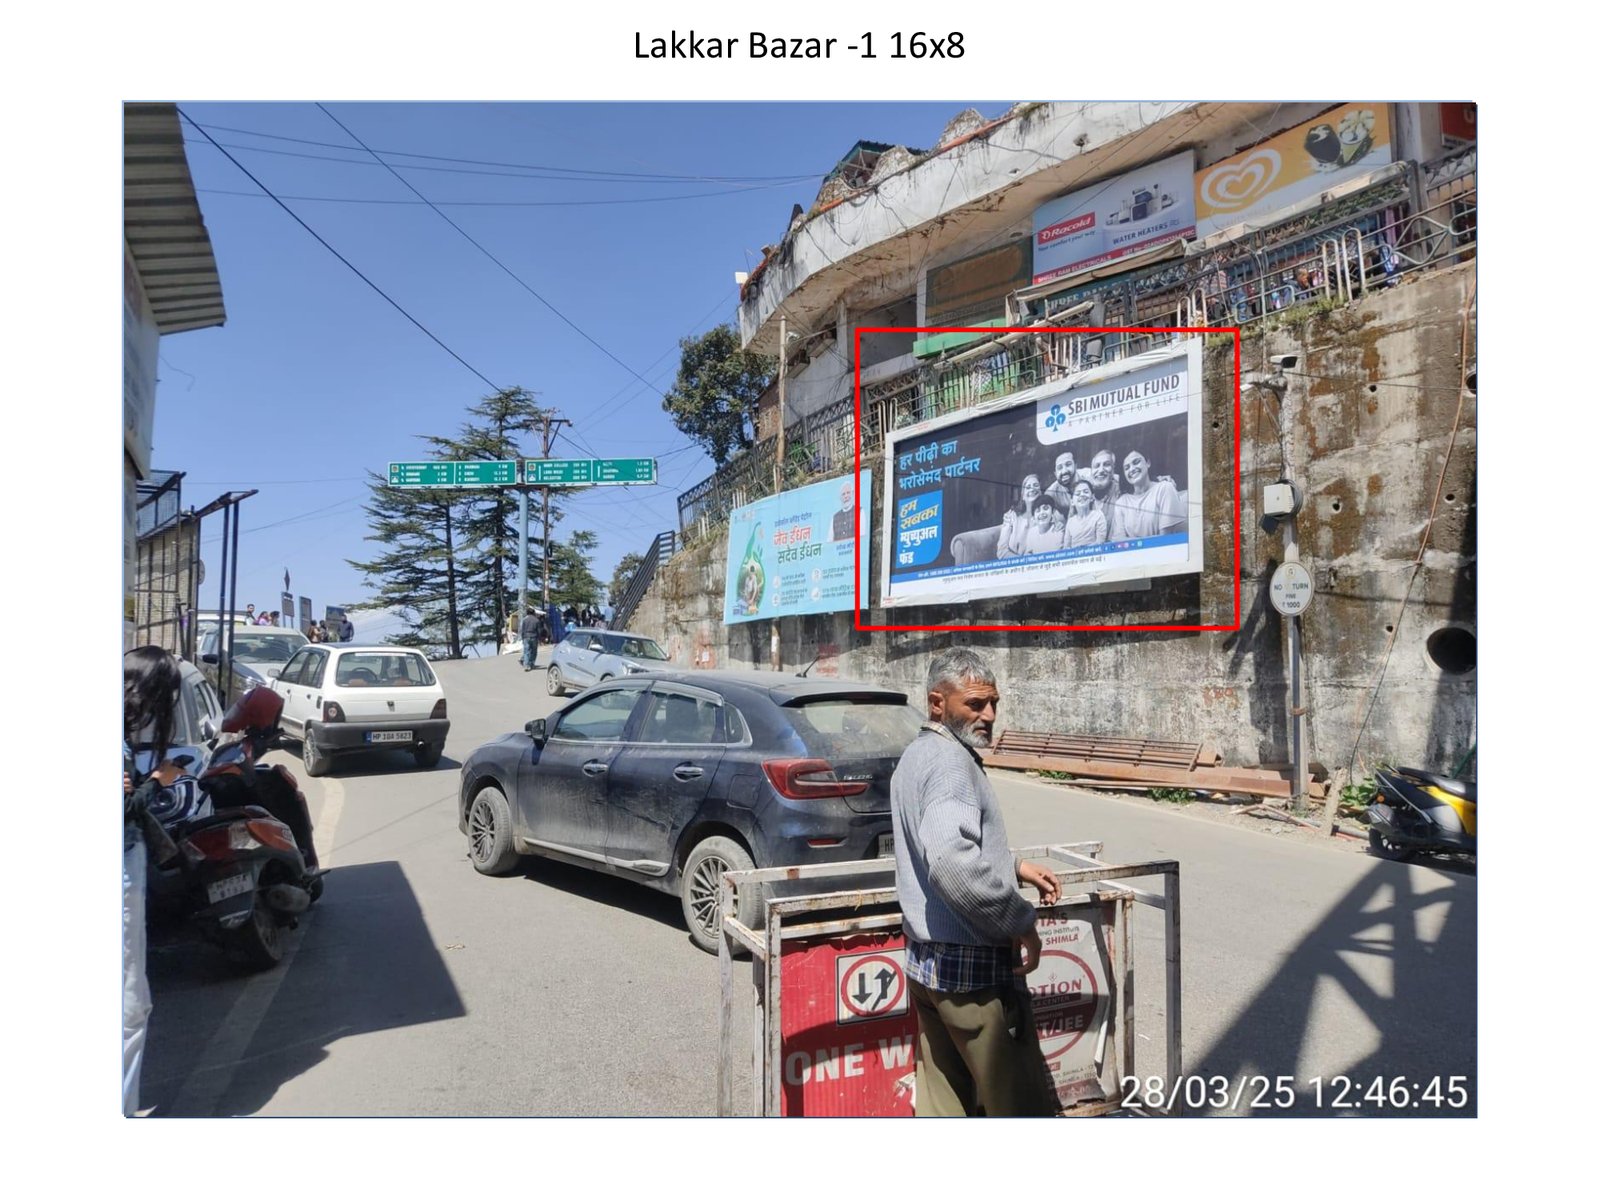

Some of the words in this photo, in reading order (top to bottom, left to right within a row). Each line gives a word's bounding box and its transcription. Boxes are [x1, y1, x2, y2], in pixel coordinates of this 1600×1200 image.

[1051, 216, 1092, 237] Racold
[1113, 231, 1136, 245] WATER
[1137, 223, 1168, 238] HEATERS
[1068, 398, 1088, 416] SBI
[1089, 385, 1141, 411] MUTUAL
[1144, 374, 1180, 396] FUND
[1079, 408, 1124, 425] PARTNER
[1130, 403, 1151, 412] FOR
[1156, 394, 1181, 407] LIFE
[899, 453, 913, 470] हर
[941, 440, 958, 456] का
[899, 464, 942, 490] भरोसेमंद
[945, 456, 982, 478] पार्टनर
[900, 499, 918, 518] हम
[900, 504, 940, 529] सबका
[899, 549, 914, 564] फंड
[1034, 912, 1069, 927] TA'S
[1045, 933, 1079, 946] SHIMLA
[1028, 978, 1082, 999] OTION
[1037, 1014, 1084, 1039] T/JEE
[785, 1042, 865, 1087] ONE
[877, 1033, 921, 1071] W
